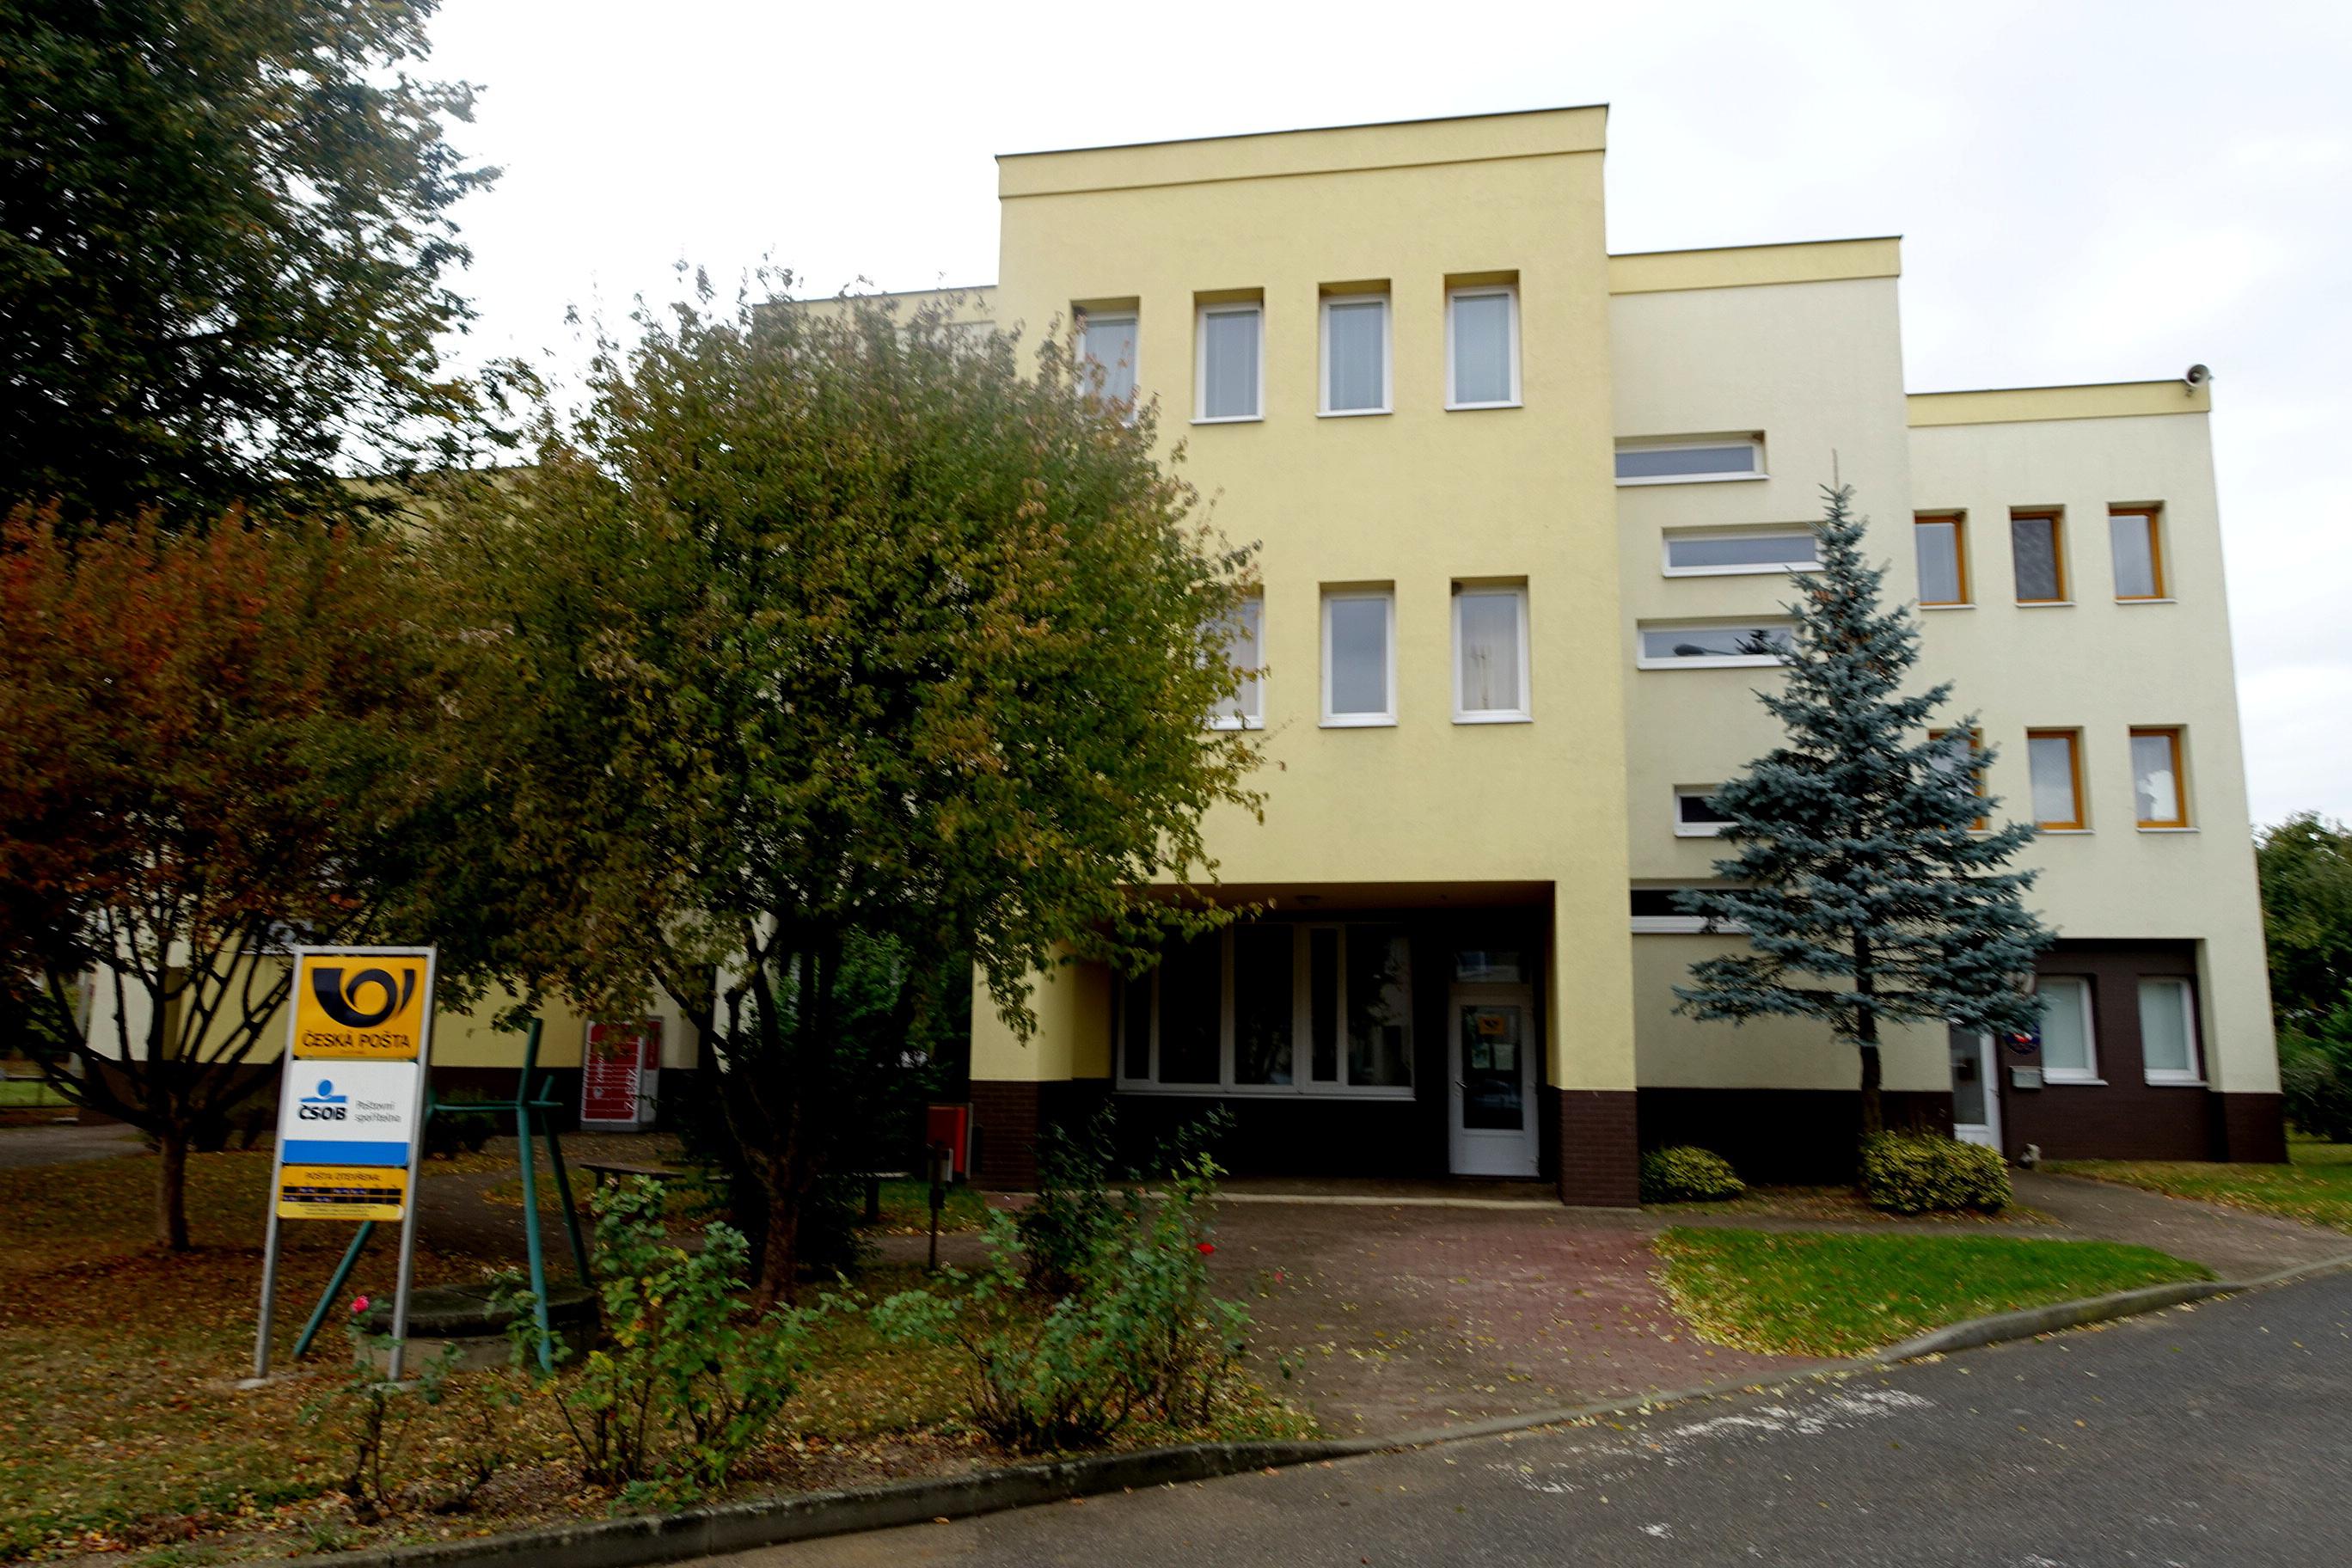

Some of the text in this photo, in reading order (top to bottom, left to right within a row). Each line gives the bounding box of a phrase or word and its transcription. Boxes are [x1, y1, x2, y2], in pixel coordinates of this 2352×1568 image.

[303, 1030, 410, 1048] ČESKÁ POŠTA
[299, 1104, 346, 1120] ČSOB
